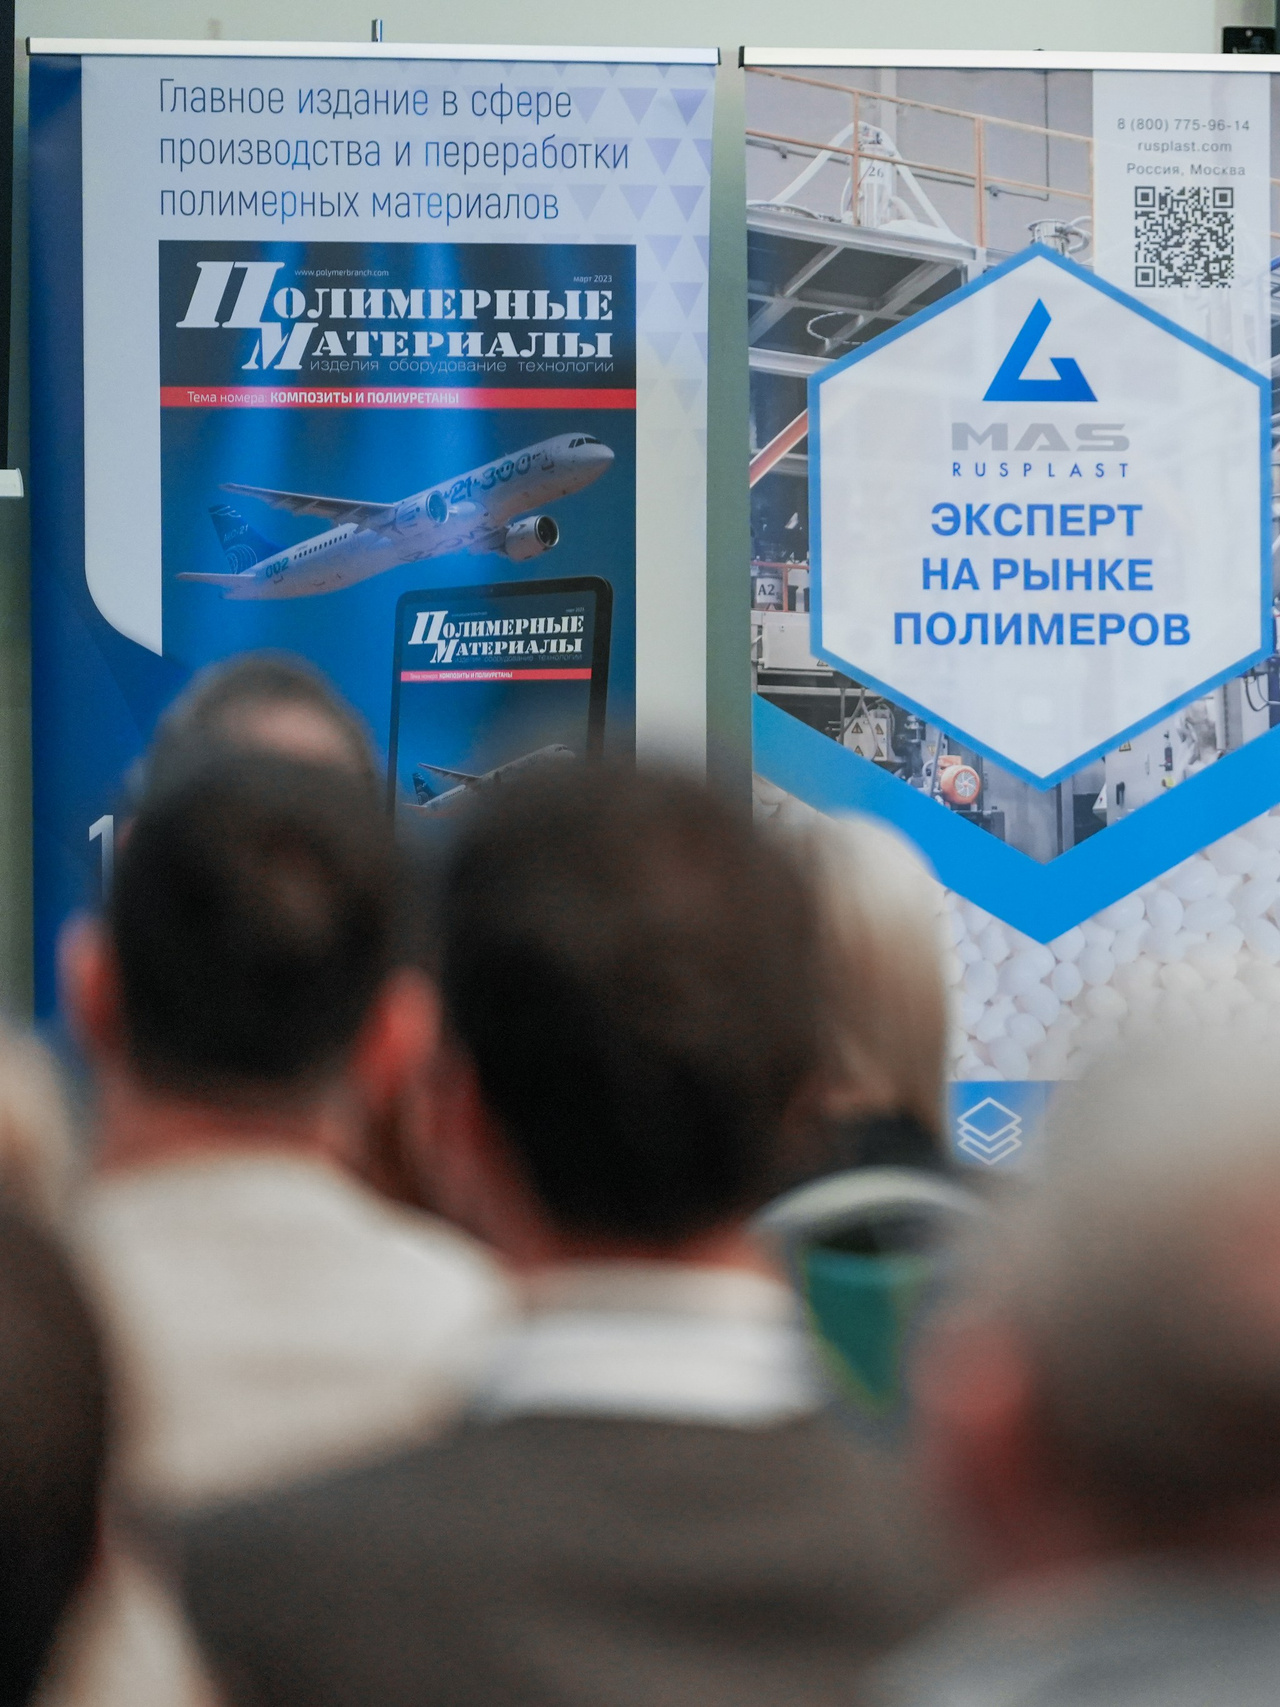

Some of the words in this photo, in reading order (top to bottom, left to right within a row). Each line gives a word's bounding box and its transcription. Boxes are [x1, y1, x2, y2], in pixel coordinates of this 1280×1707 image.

[160, 78, 285, 114] Главное
[298, 87, 429, 120] издание
[442, 90, 458, 116] в
[471, 83, 572, 125] сфере
[1117, 118, 1126, 130] 8
[1130, 118, 1169, 132] (800)
[1174, 118, 1250, 131] 775-96-14
[1137, 141, 1232, 152] rusplast.com
[160, 138, 381, 172] производства
[395, 141, 411, 167] и
[425, 134, 628, 176] переработки
[1126, 163, 1185, 176] Россия,
[1190, 164, 1246, 176] Москва
[160, 189, 360, 225] полимерных
[372, 191, 559, 227] материалов
[294, 269, 389, 278] www.polymerbranch.com
[573, 276, 592, 284] март
[593, 275, 613, 283] 2023
[310, 360, 379, 373] изделия
[389, 359, 507, 375] оборудование
[517, 361, 614, 373] технологии
[187, 391, 217, 403] Тема
[220, 393, 268, 405] номера:
[270, 391, 352, 404] КОМПОЗИТЫ
[355, 392, 365, 404] И
[367, 392, 459, 404] ПОЛИУРЕТАНЫ
[951, 422, 1130, 451] MAS
[952, 462, 1128, 478] RUSPLAST
[931, 502, 1143, 537] ЭКСПЕРТ
[922, 558, 980, 590] НА
[993, 558, 1154, 591] РЫНКЕ
[894, 612, 1191, 646] ПОЛИМЕРОВ
